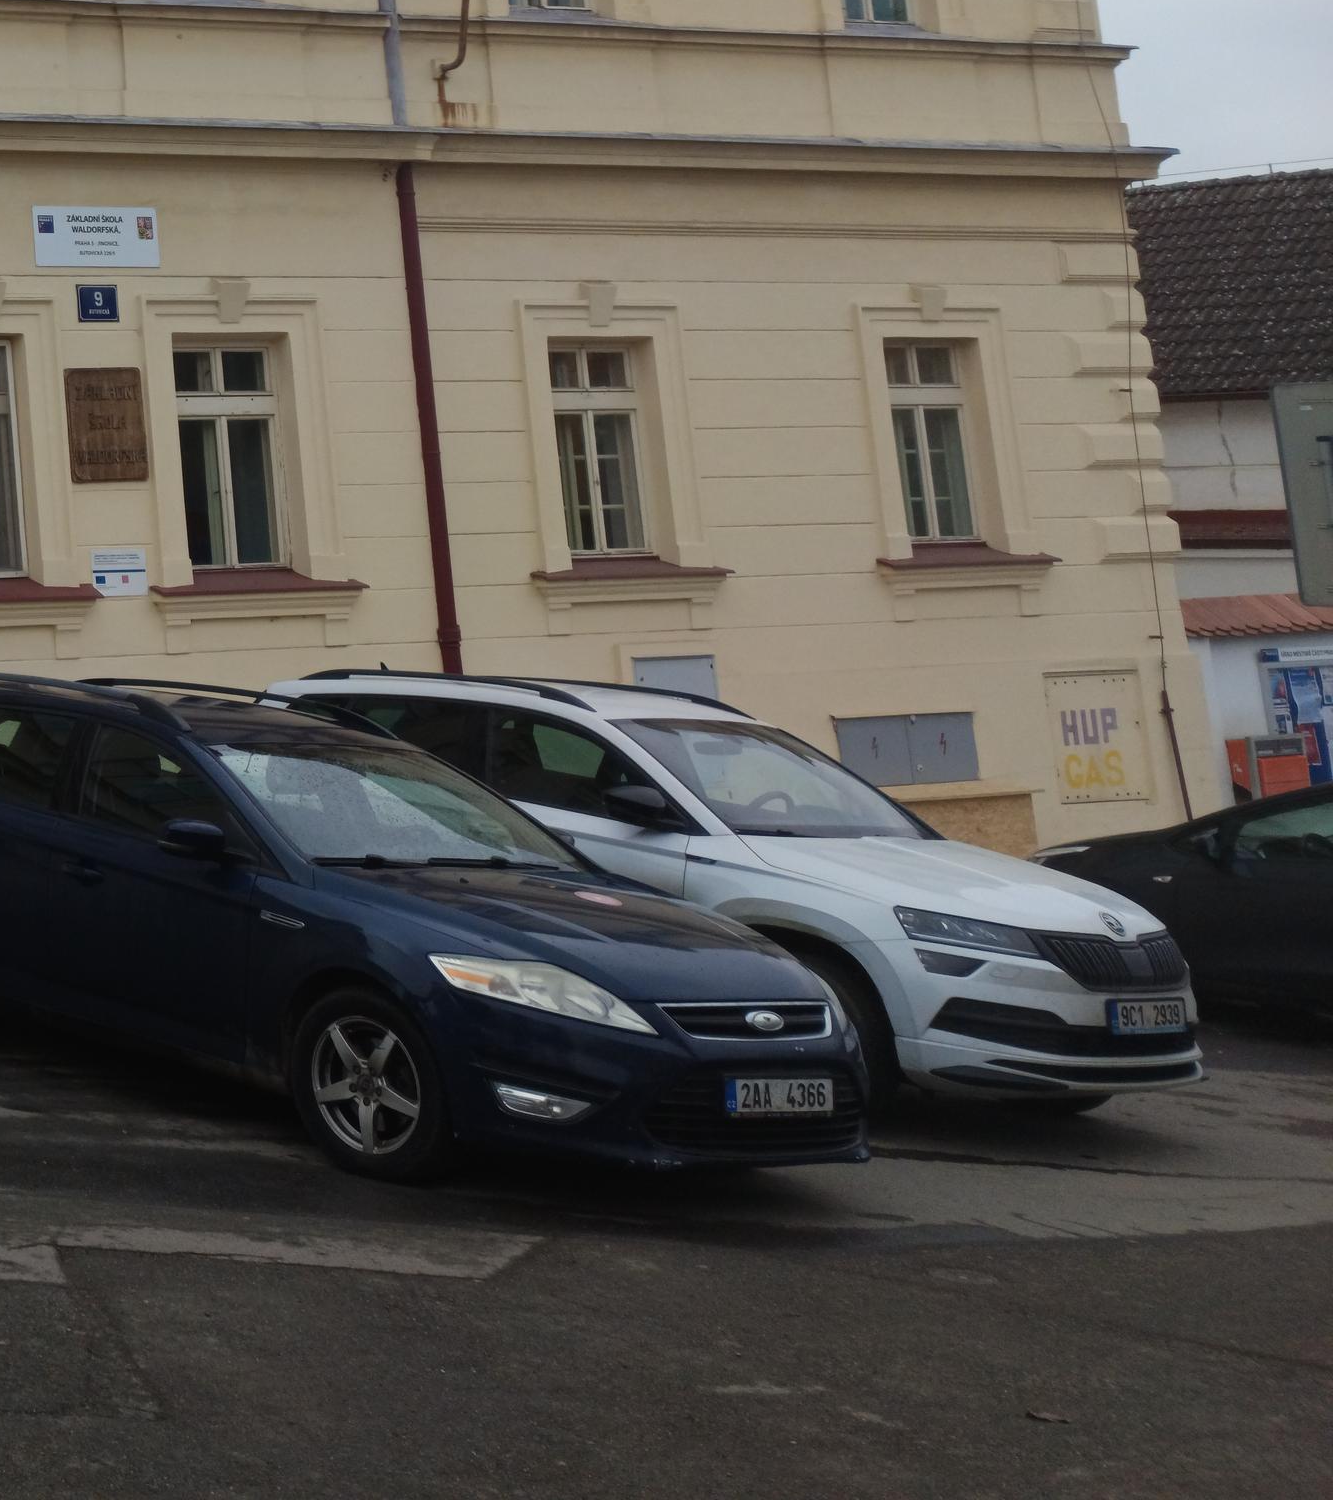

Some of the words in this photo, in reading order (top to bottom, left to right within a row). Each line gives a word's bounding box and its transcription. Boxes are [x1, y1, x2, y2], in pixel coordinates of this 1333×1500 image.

[66, 214, 101, 223] ZÁKLADNÍ
[101, 214, 124, 223] ŠKOLA
[94, 291, 103, 307] 9
[1060, 707, 1118, 747] HUP
[1064, 749, 1126, 789] GAS
[1121, 1005, 1145, 1027] 9C1
[1153, 1003, 1181, 1026] 2939
[741, 1082, 773, 1109] 2AA
[786, 1082, 827, 1108] 4366
